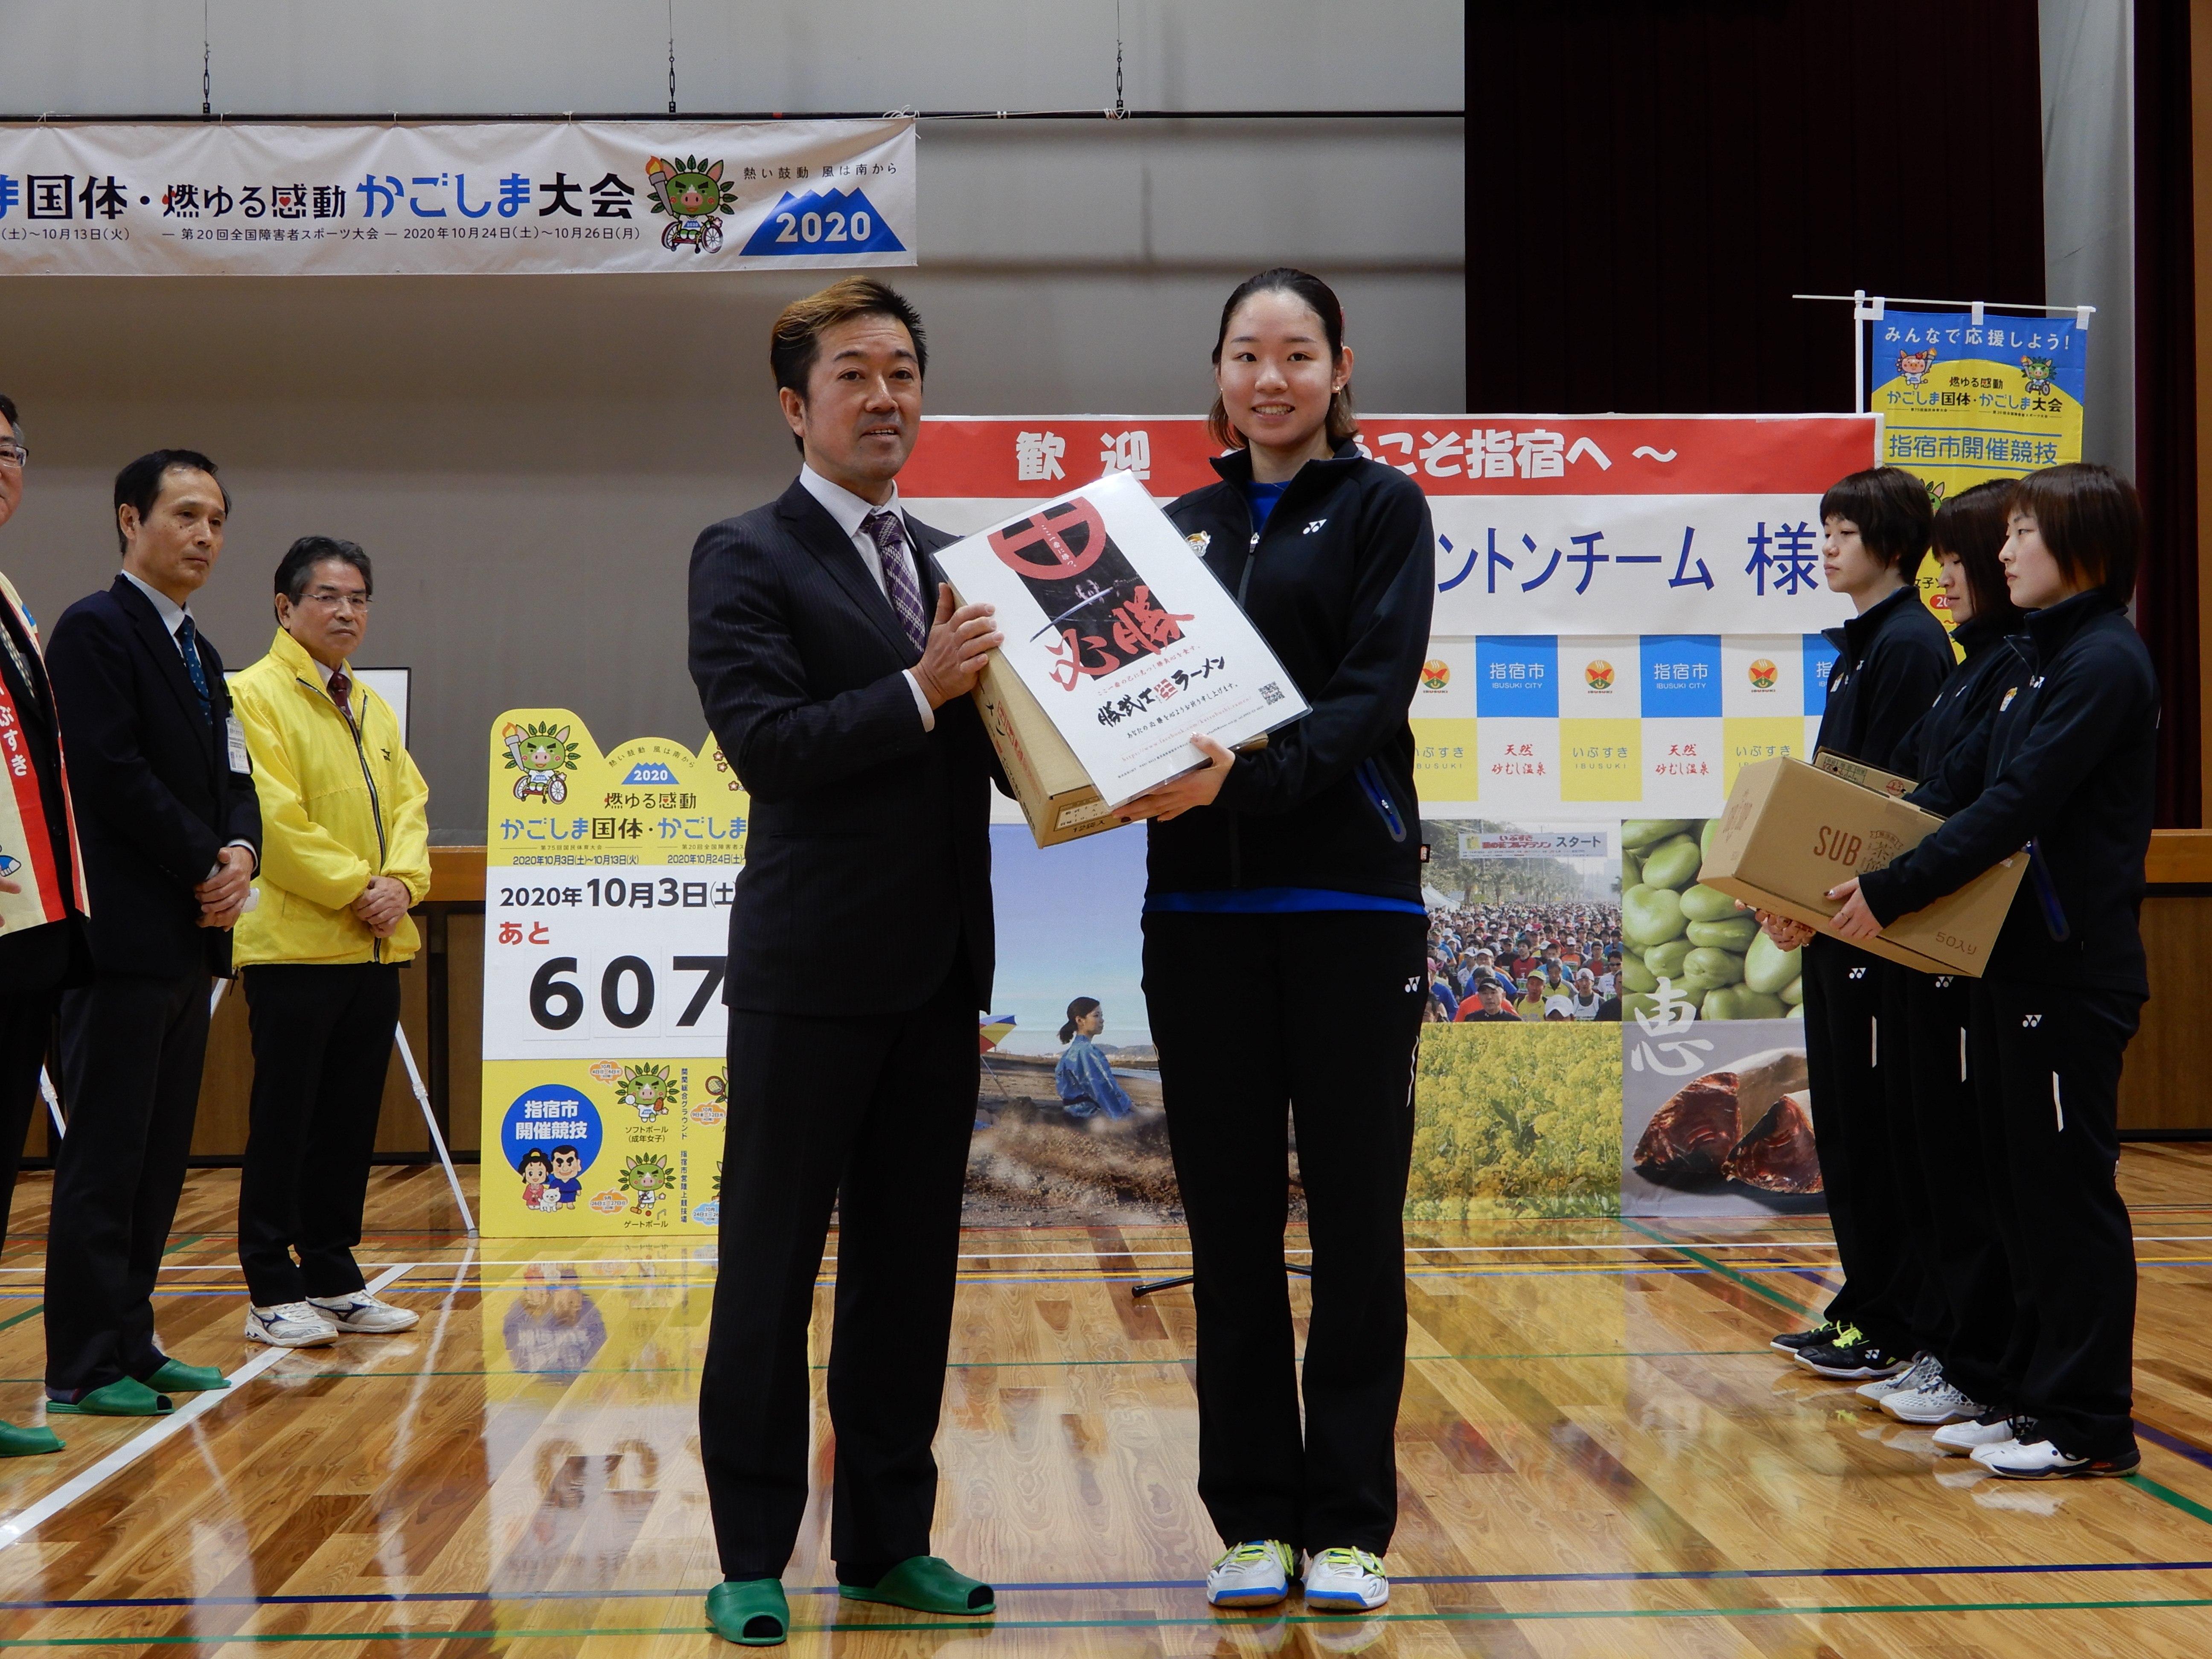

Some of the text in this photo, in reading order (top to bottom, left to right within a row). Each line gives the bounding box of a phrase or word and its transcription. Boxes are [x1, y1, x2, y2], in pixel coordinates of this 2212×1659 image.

[744, 161, 897, 180] 熱い鼓動 風は南から
[181, 227, 378, 242] 第20回全国障害者スポーツ大会
[776, 211, 871, 243] 2020
[1885, 327, 2069, 349] みんなで応援しよう!
[1949, 376, 2003, 390] 燃ゆる感動
[1889, 434, 2058, 465] 指宿市開催競技
[1045, 585, 1195, 692] 必勝
[1490, 662, 1545, 679] 指宿市
[1654, 663, 1708, 680] 指宿市
[608, 746, 695, 768] 熱い鼓動 風は南から
[1504, 743, 1534, 757] 天然
[1573, 747, 1628, 758] いぶすき
[1668, 743, 1697, 757] 天然
[1737, 745, 1790, 757] いぶすき
[634, 770, 668, 781] 2020
[1492, 762, 1545, 776] 砂むし温泉
[1655, 762, 1709, 776] 砂むし温泉
[604, 792, 696, 809] 燃ゆる感動
[1556, 835, 1601, 848] スタート
[1814, 826, 1862, 866] SUB
[498, 921, 550, 945] あと
[525, 1100, 579, 1119] 指宿市
[515, 1121, 588, 1141] 開催競技
[629, 1135, 666, 1143] (成年女子)
